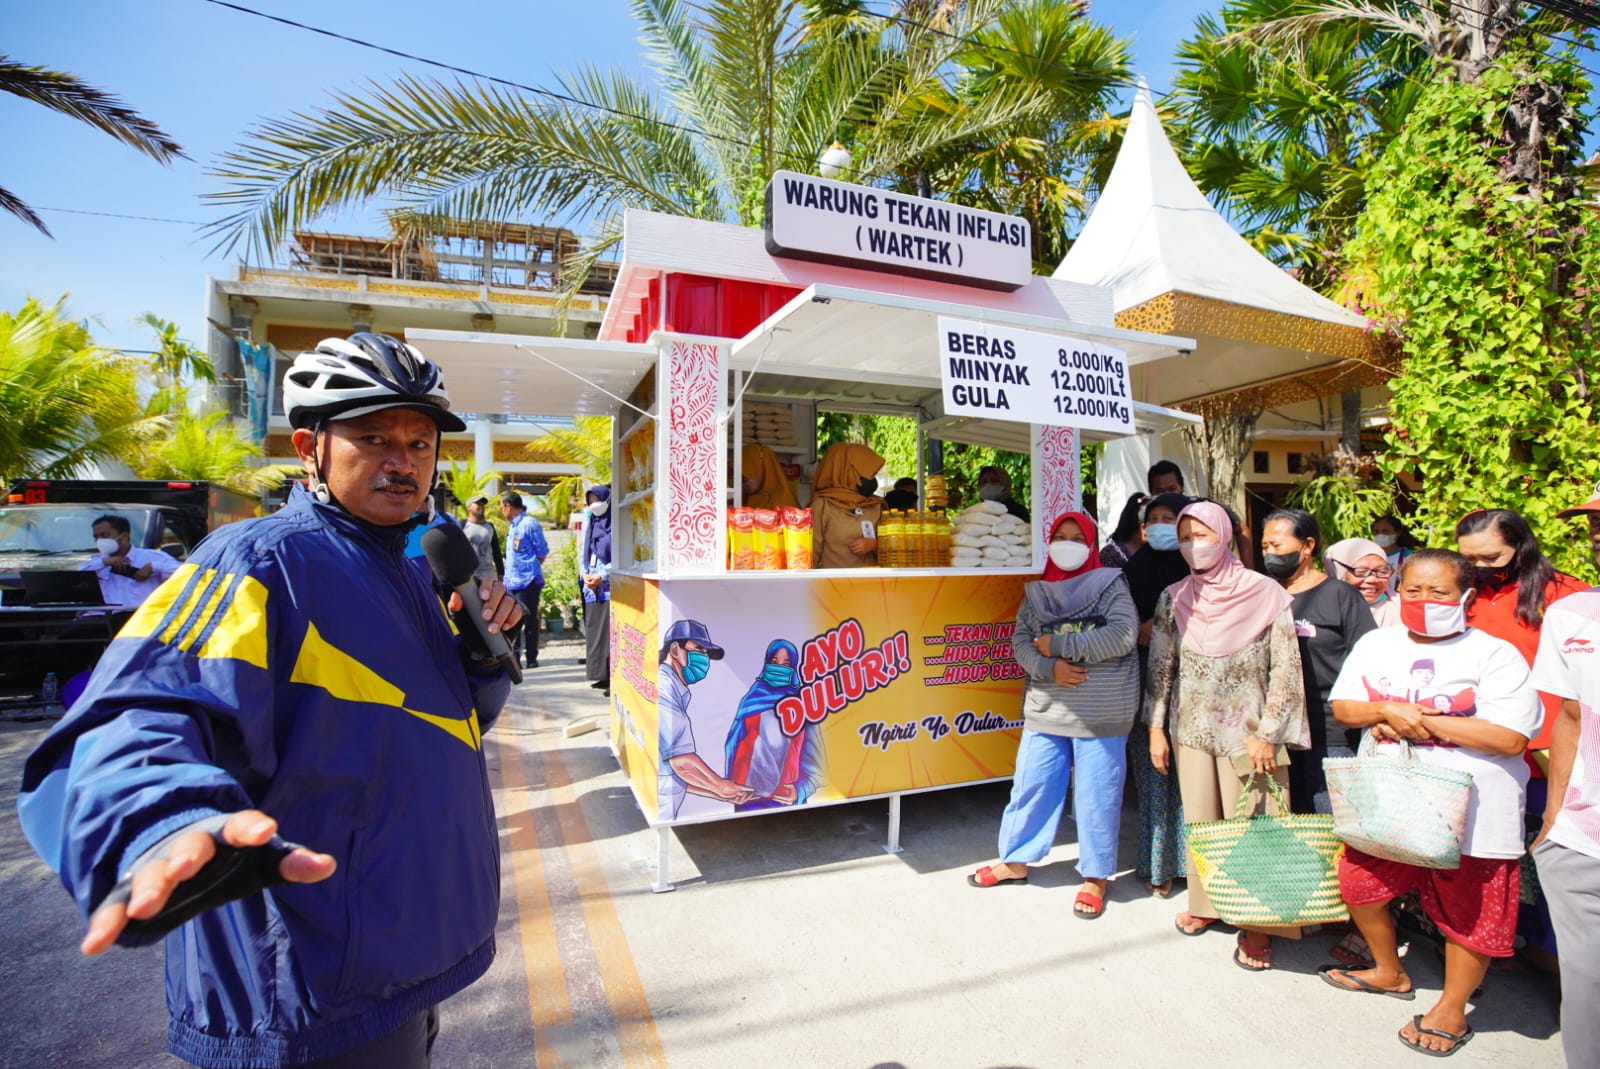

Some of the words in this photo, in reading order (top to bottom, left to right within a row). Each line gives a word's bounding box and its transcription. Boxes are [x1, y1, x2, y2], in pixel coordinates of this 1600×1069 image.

[784, 179, 878, 219] WARUNG
[885, 199, 950, 233] TEKAN
[957, 213, 1026, 247] INFLASI
[947, 332, 1016, 360] BERAS
[1058, 349, 1124, 378] 8.000/Kg
[949, 357, 1030, 386] MINYAK
[1050, 370, 1126, 397] 12.000/Lt
[952, 385, 1010, 410] GULA
[1053, 395, 1129, 424] 12.000/Kg
[802, 620, 862, 682] AYO
[777, 632, 910, 735] DULUR!!
[859, 722, 916, 750] Ngirit
[922, 716, 949, 739] Yo
